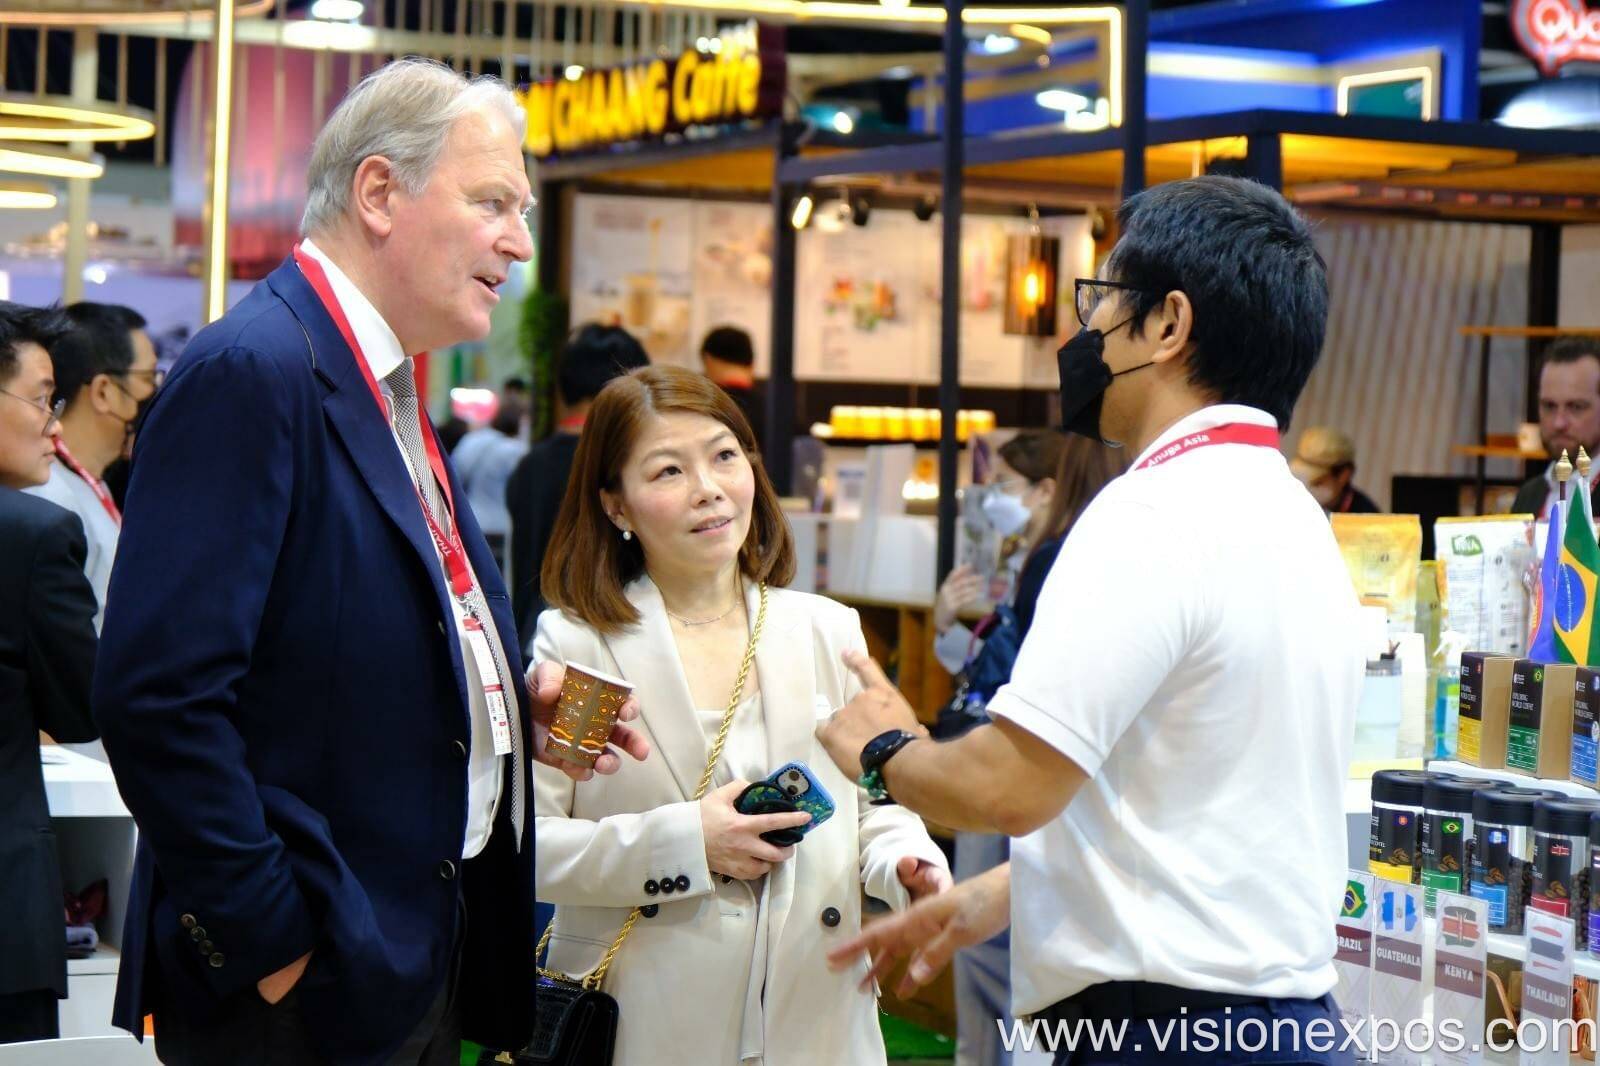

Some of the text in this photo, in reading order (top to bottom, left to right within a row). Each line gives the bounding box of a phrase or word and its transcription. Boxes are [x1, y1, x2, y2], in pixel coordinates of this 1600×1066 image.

[1148, 434, 1210, 467] Anuga Asia
[1376, 946, 1422, 967] GUATEMALA
[1444, 963, 1474, 983] KENYA
[1526, 984, 1567, 1008] THAILAND
